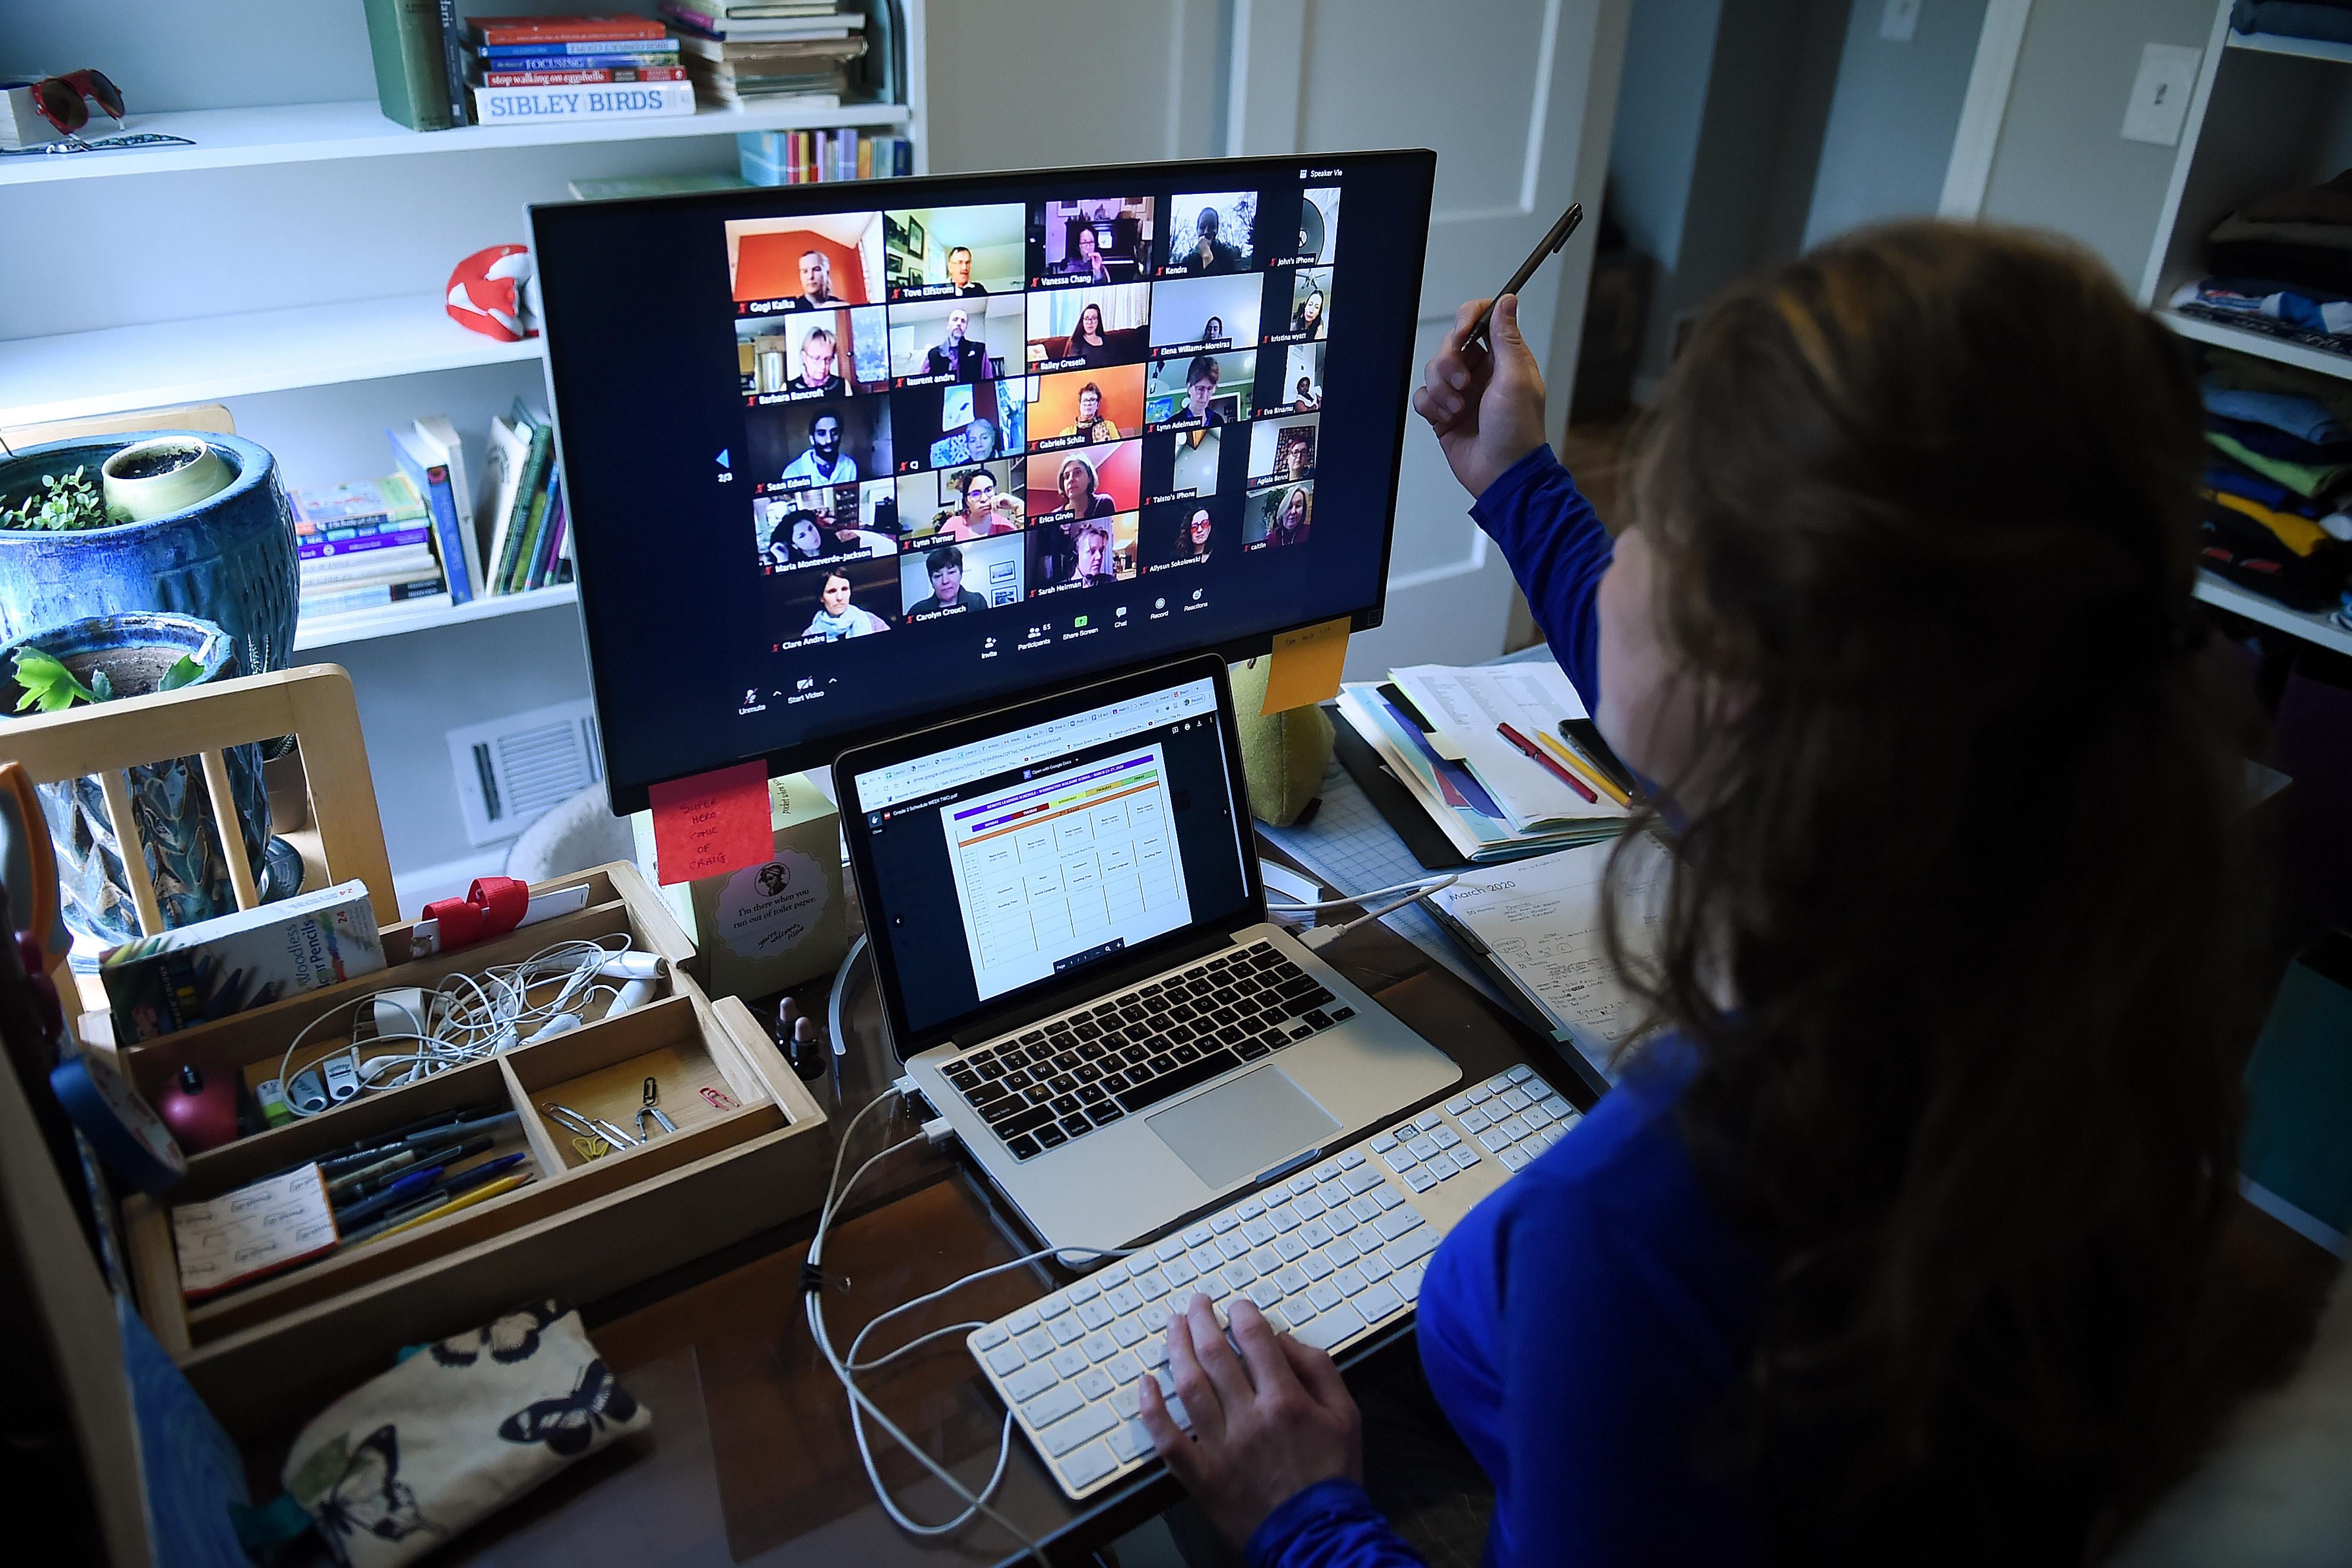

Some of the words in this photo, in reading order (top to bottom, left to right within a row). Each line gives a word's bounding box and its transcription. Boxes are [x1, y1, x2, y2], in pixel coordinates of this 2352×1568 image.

[492, 75, 512, 87] stop
[513, 72, 550, 86] walking
[550, 74, 563, 82] on
[563, 70, 605, 85] eggshells
[491, 93, 579, 117] SIBLEY
[589, 90, 663, 113] BIRDS
[1310, 169, 1332, 178] Speaker
[1296, 256, 1314, 264] iPhone
[1166, 267, 1187, 275] Kendra
[1041, 277, 1069, 286] Vanessa
[1070, 275, 1091, 285] Chang
[1271, 334, 1291, 342] kristina
[1292, 333, 1306, 342] wyatt
[1178, 341, 1230, 353] Williams-Moreiras
[1040, 361, 1059, 371] Bailey
[1060, 358, 1085, 367] Greseth
[907, 376, 933, 385] laurent
[934, 373, 955, 383] andre
[791, 388, 824, 400] Bancroft
[1156, 423, 1171, 432] Lynn
[1172, 419, 1201, 429] Adelmann
[1040, 439, 1066, 449] Gabriele
[718, 473, 732, 482] 2/3
[767, 482, 786, 491] Sean
[1177, 490, 1195, 500] iPhone
[1039, 515, 1054, 524] Erica
[913, 538, 929, 548] Lynn
[931, 535, 954, 544] Turner
[775, 563, 796, 573] Maria
[798, 550, 871, 569] Monteverde-Jackson
[1038, 587, 1055, 596] Sarah
[1184, 601, 1208, 612] Reactions
[916, 611, 941, 622] Carolyn
[943, 606, 966, 616] Crouch
[1150, 610, 1168, 620] Record
[1063, 632, 1079, 640] Share
[1079, 627, 1098, 637] Screen
[782, 639, 802, 651] Clare
[804, 635, 825, 646] Andre
[1018, 638, 1050, 651] Participants
[981, 650, 997, 659] Invite
[788, 695, 804, 705] Start
[804, 690, 824, 702] Video
[739, 703, 766, 715] Unmute
[680, 798, 716, 814] SUPER
[909, 802, 928, 811] Schedule
[692, 812, 716, 824] HERO
[691, 827, 717, 839] COMIC
[697, 843, 710, 853] OF
[689, 853, 726, 869] CRAIG
[1449, 887, 1486, 901] March
[1487, 880, 1516, 892] 2020
[738, 908, 751, 917] I'm
[753, 901, 772, 912] there
[774, 894, 794, 904] when
[796, 889, 810, 898] you
[764, 909, 772, 918] of
[773, 904, 792, 915] toilet
[794, 897, 816, 909] paper.
[337, 911, 348, 924] 24
[301, 920, 324, 963] Pencils
[286, 924, 311, 983] Woodless
